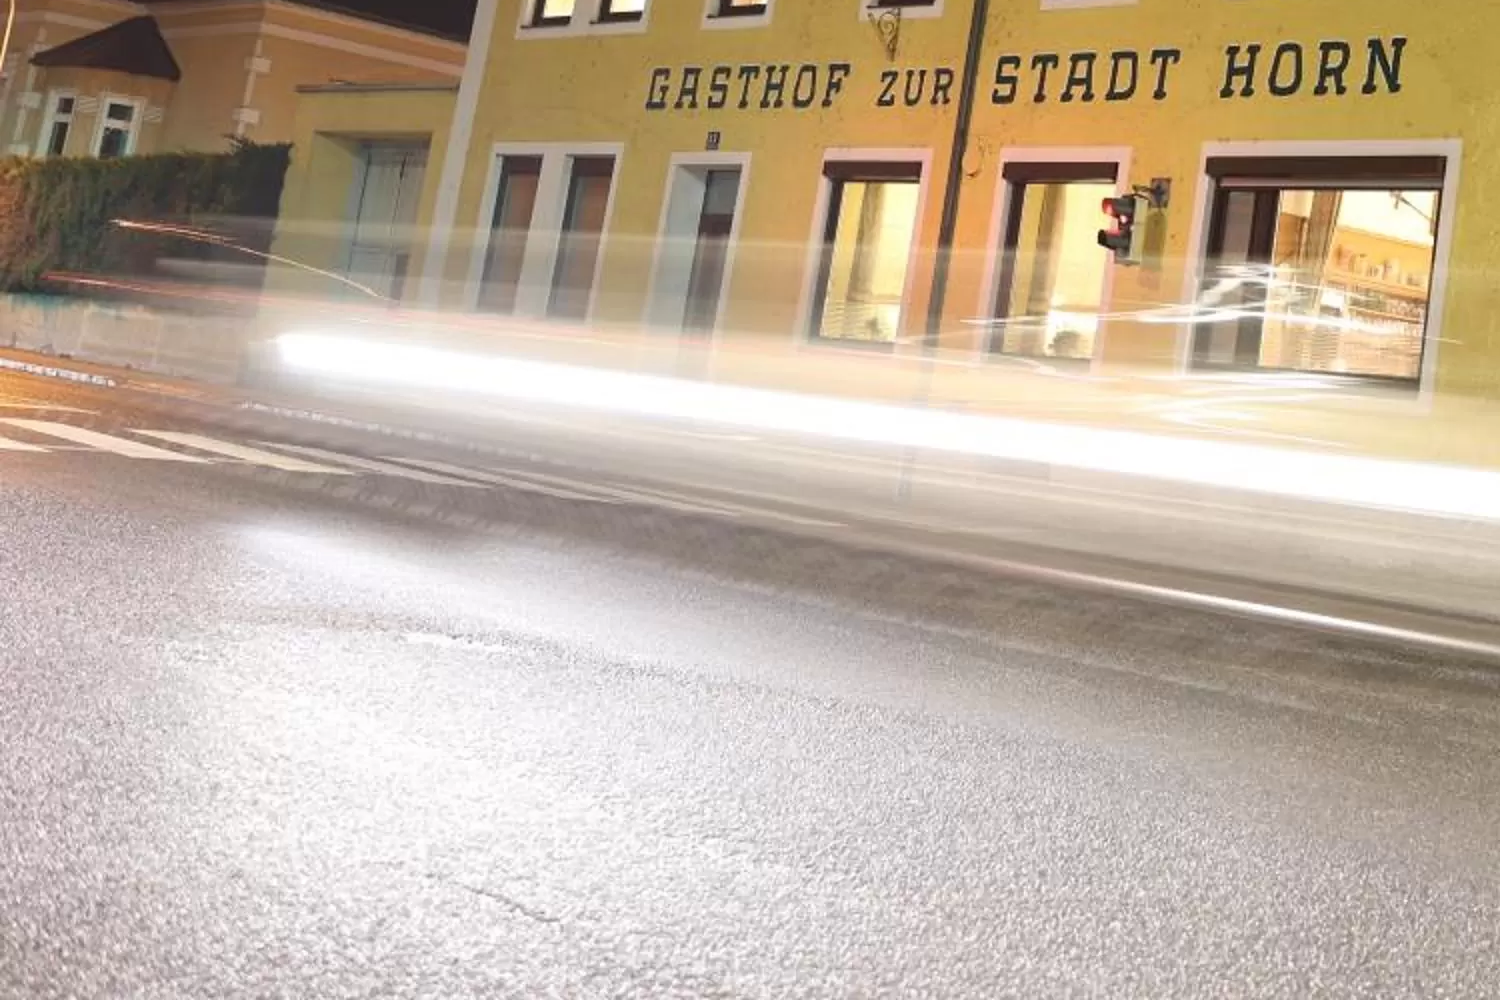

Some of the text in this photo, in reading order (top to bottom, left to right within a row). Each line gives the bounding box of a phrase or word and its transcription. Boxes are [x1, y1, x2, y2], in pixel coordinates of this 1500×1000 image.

[645, 37, 1407, 110] GASTHOF ZUR STADT HORN
